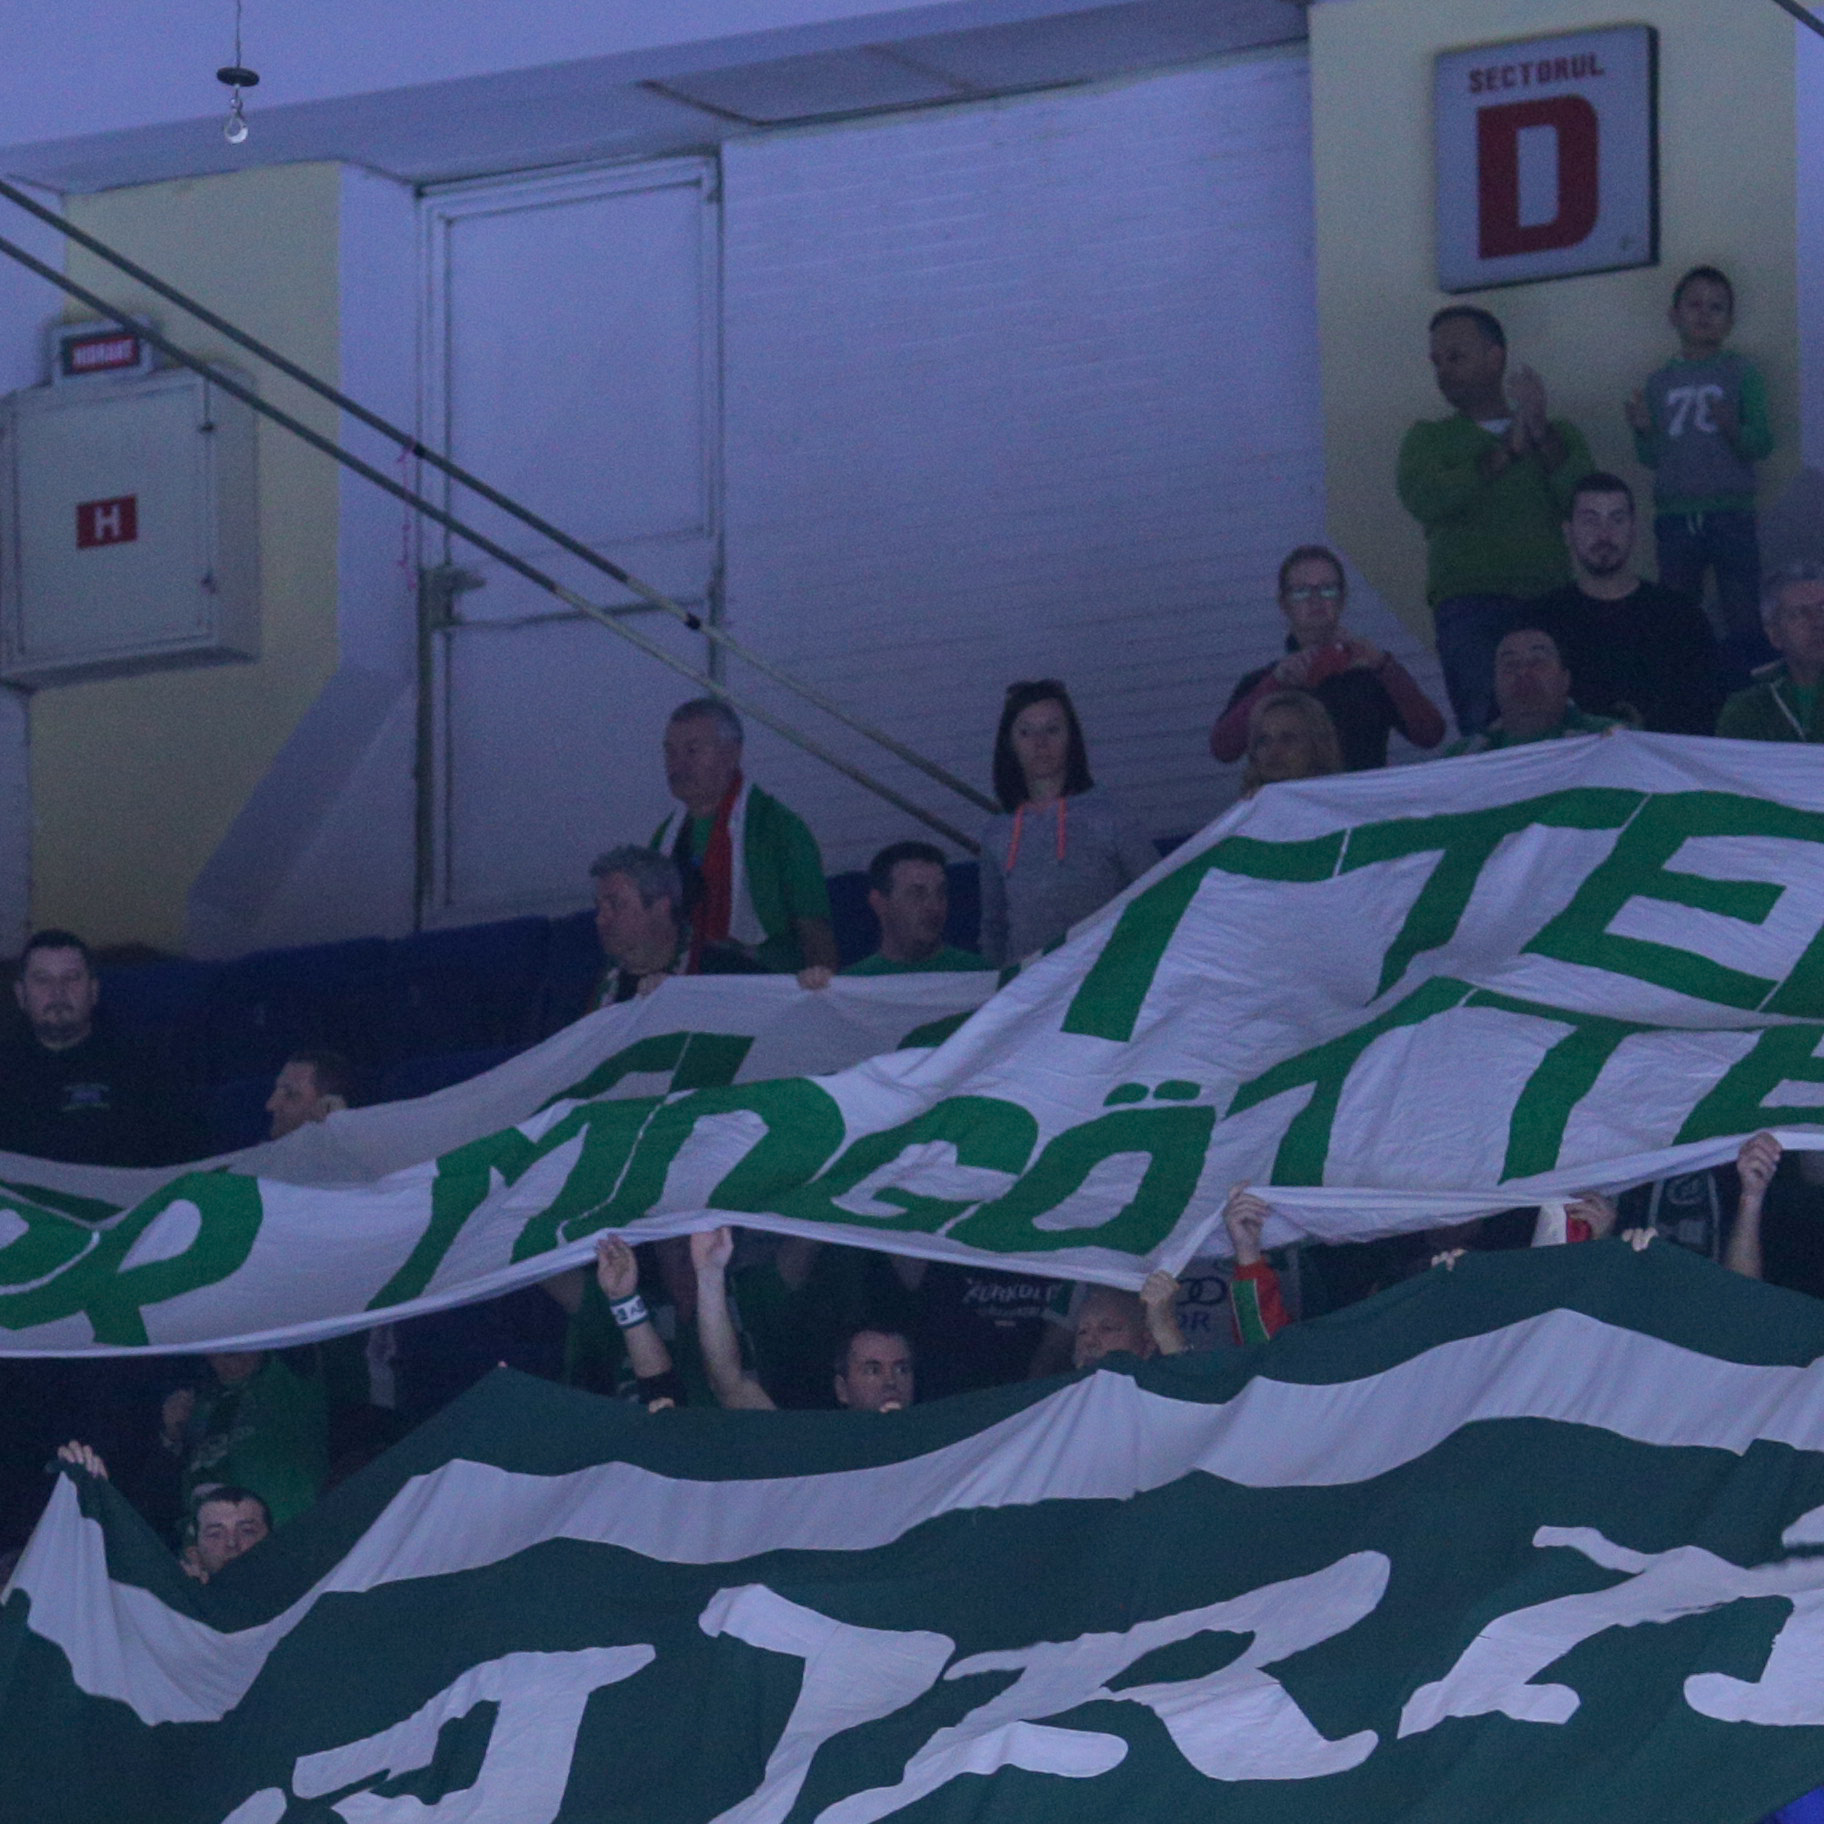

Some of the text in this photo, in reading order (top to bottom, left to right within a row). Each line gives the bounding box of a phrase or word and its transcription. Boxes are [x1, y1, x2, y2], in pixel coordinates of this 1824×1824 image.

[1468, 54, 1604, 93] SECTORUL
[1477, 93, 1599, 259] D
[95, 503, 122, 538] H
